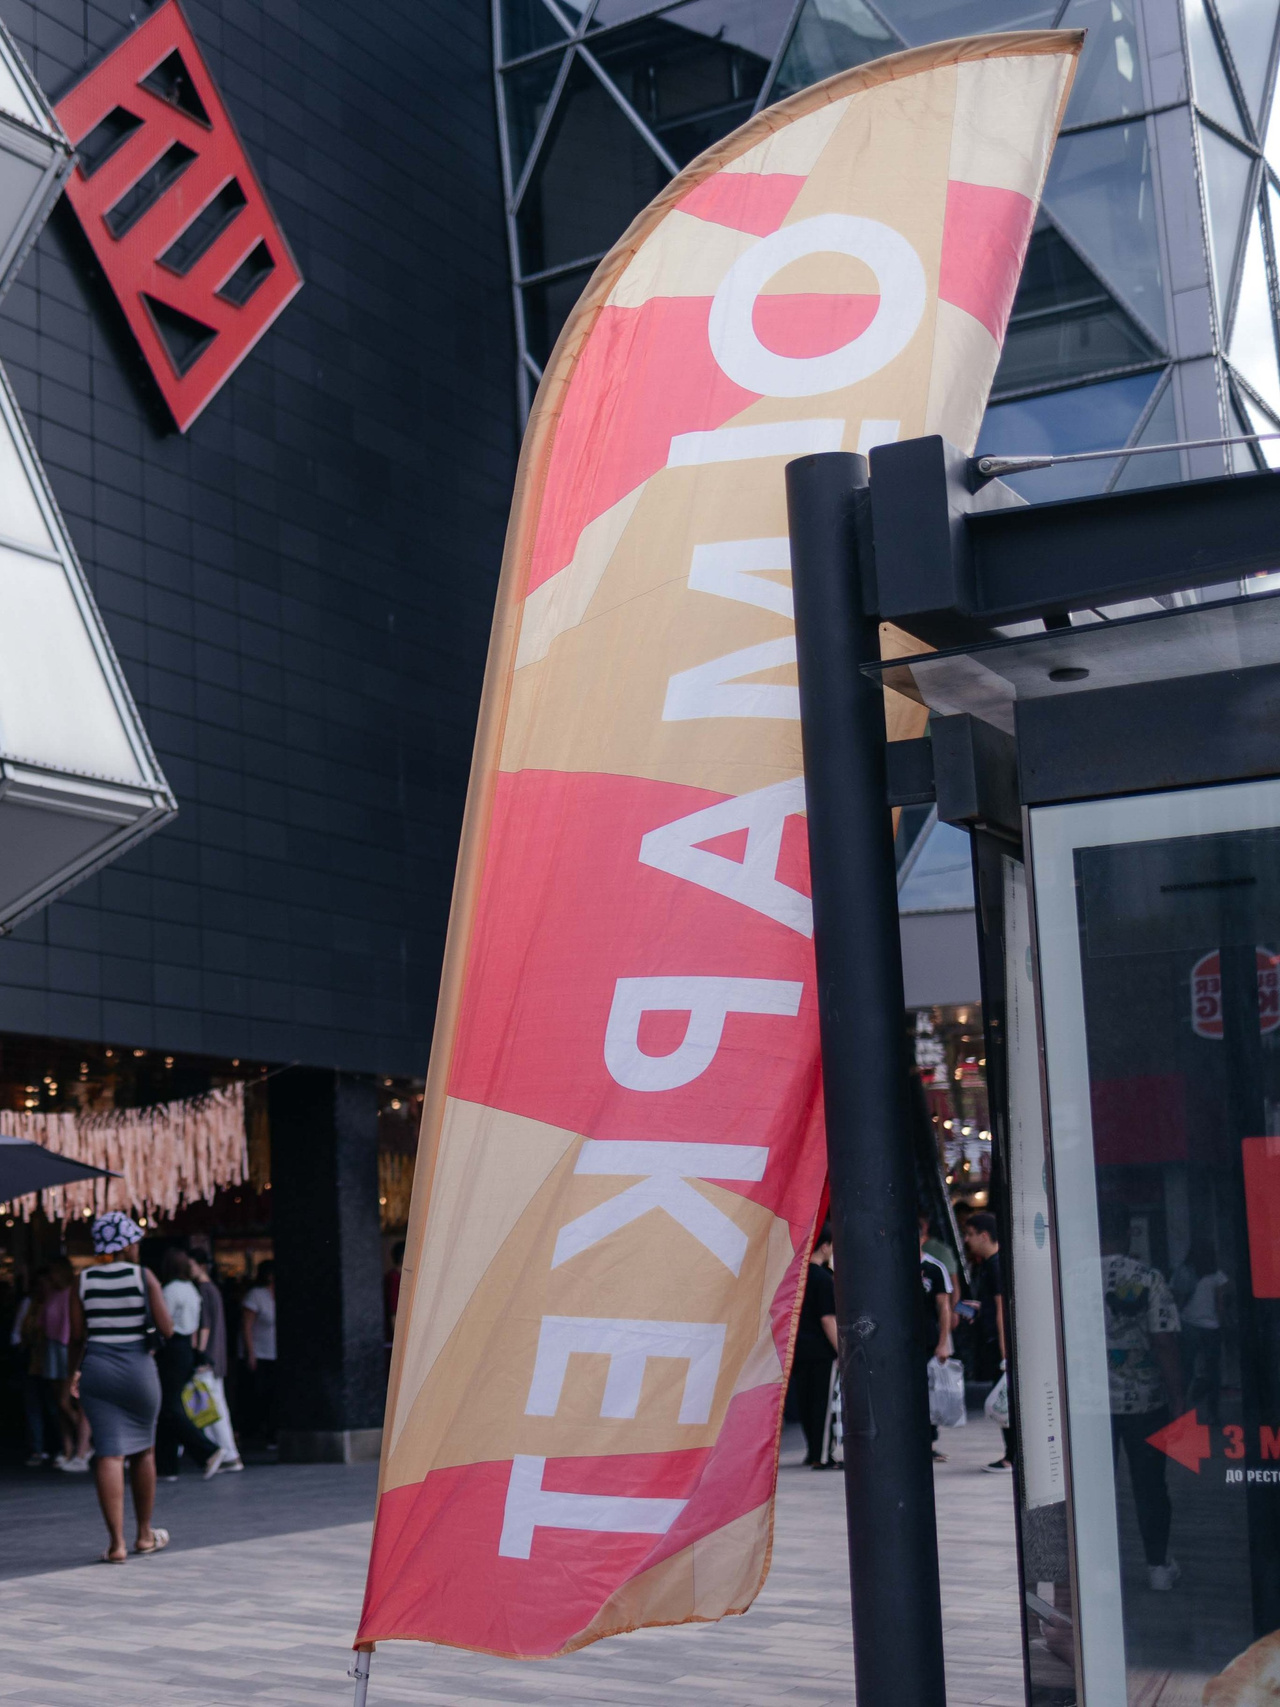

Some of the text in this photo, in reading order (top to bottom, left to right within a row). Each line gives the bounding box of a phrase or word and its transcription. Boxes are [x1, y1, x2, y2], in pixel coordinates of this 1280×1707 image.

[1223, 1424, 1246, 1459] 3
[1226, 1469, 1280, 1484] ДО РЕСТ
